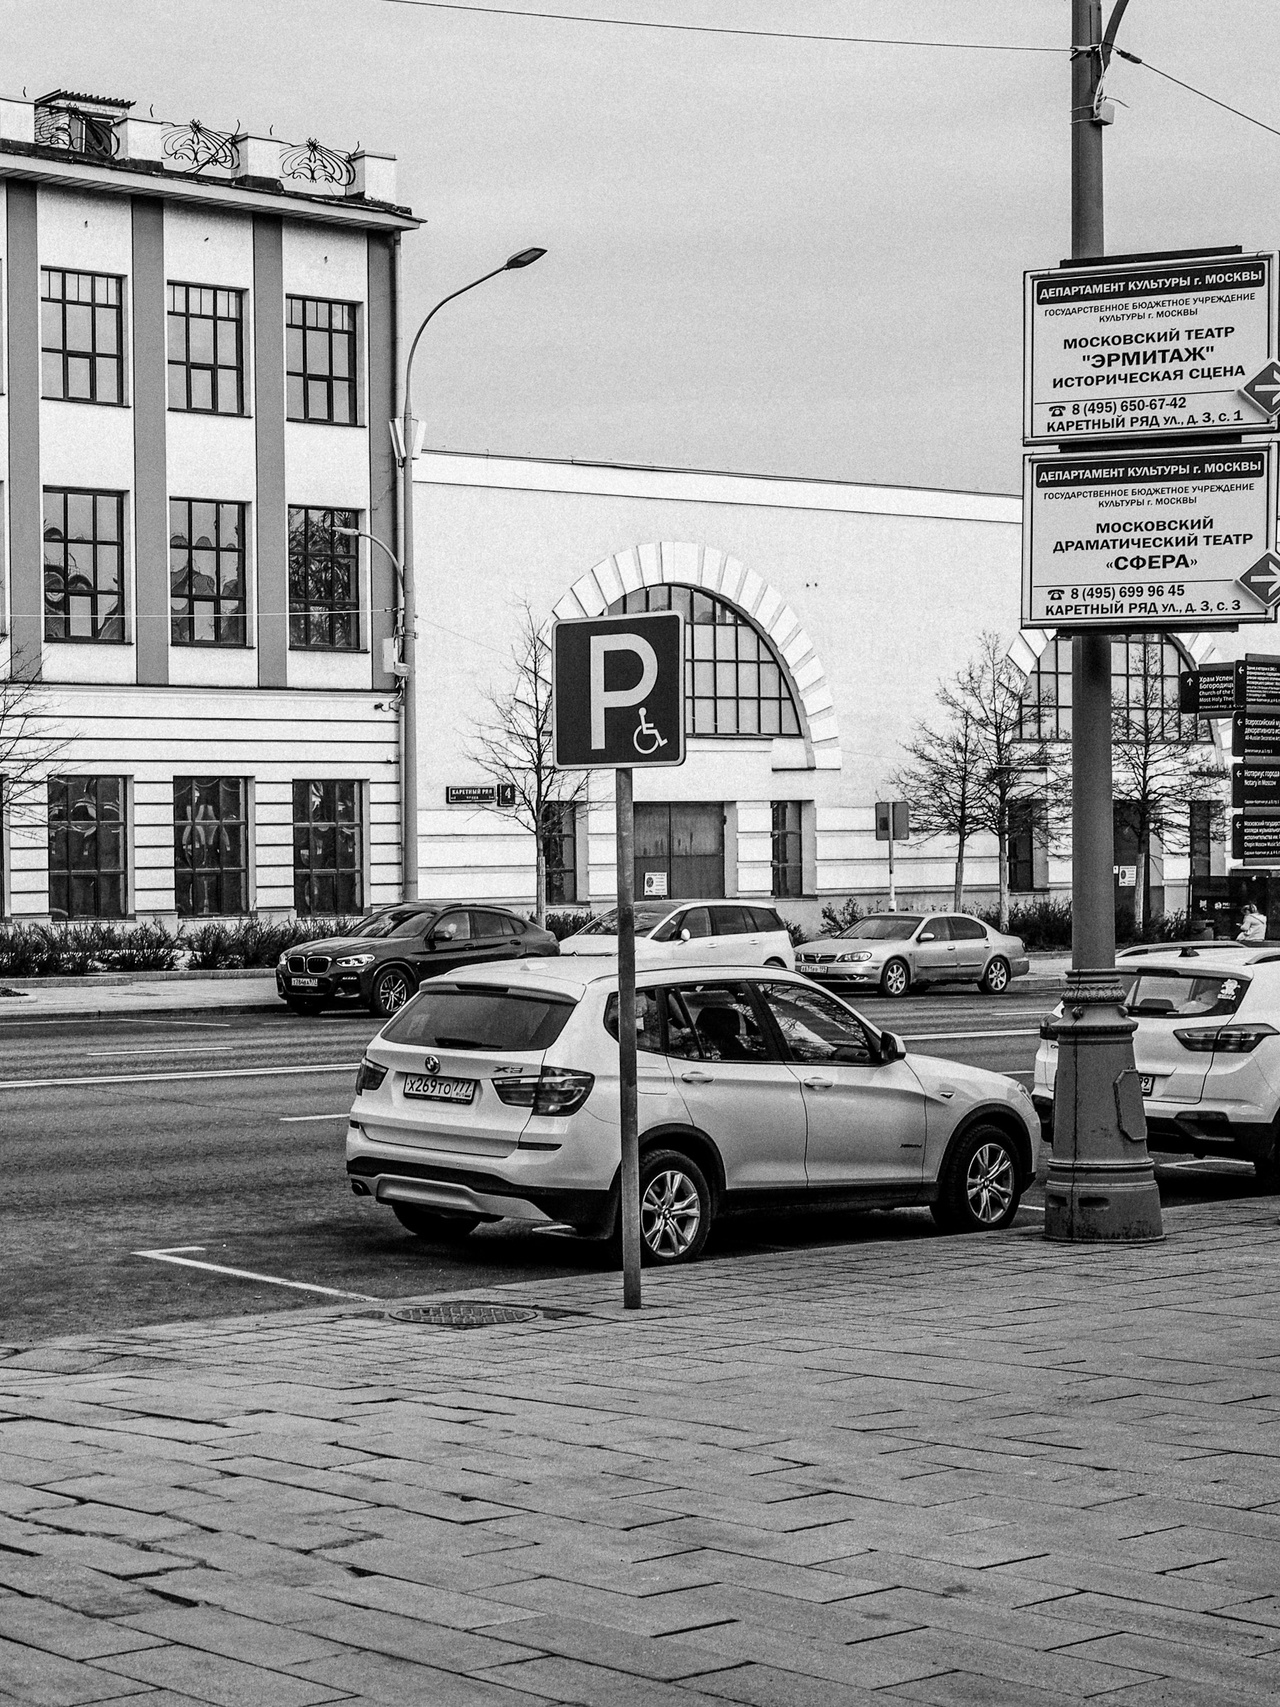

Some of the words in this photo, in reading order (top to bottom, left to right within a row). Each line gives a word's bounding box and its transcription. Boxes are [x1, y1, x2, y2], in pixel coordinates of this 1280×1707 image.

[1040, 283, 1125, 299] ДЕПАРТАМЕНТ
[1128, 277, 1190, 291] КУЛЬТУРЫ
[1205, 271, 1262, 284] МОСКВЫ
[1044, 303, 1130, 317] ГОСУДАРСТВЕННОЕ
[1132, 298, 1190, 310] БЮДЖЕТНОЕ
[1193, 293, 1255, 305] УЧРЕЖДЕНИЕ
[1099, 313, 1145, 322] КУЛЬТУРЫ
[1157, 309, 1198, 318] МОСКВЫ
[1063, 329, 1179, 349] МОСКОВСКИЙ
[1185, 327, 1235, 340] ТЕАТР
[1083, 346, 1214, 368] "ЭРМИТАЖ"
[1053, 370, 1183, 388] ИСТОРИЧЕСКАЯ
[1189, 366, 1245, 380] СЦЕНА
[1072, 404, 1080, 415] 8
[1084, 402, 1117, 417] (495)
[1121, 398, 1186, 412] 650-67-42
[1047, 416, 1125, 432] КАРЕТНЫЙ
[1130, 416, 1160, 428] РЯД
[1164, 416, 1184, 426] ул.,
[1187, 415, 1199, 425] д.
[1202, 413, 1215, 424] 3,
[1219, 413, 1230, 421] с.
[1234, 410, 1243, 420] 1
[1039, 468, 1124, 482] ДЕПАРТАМЕНТ
[1128, 465, 1190, 476] КУЛЬТУРЫ
[1204, 461, 1261, 473] МОСКВЫ
[1044, 489, 1129, 500] ГОСУДАРСТВЕННОЕ
[1131, 486, 1189, 496] БЮДЖЕТНОЕ
[1192, 483, 1254, 493] УЧРЕЖДЕНИЕ
[1098, 499, 1145, 508] КУЛЬТУРЫ
[1096, 516, 1214, 533] МОСКОВСКИЙ
[1053, 532, 1198, 553] ДРАМАТИЧЕСКИЙ
[1203, 534, 1253, 546] ТЕАТР
[1106, 554, 1198, 570] «СФЕРА»
[1071, 588, 1078, 599] 8
[1082, 587, 1116, 601] (495)
[1119, 587, 1144, 598] 699
[1148, 586, 1164, 596] 96
[1168, 585, 1185, 595] 45
[1046, 601, 1124, 616] КАРЕТНЫЙ
[1129, 602, 1158, 614] РЯД
[1161, 603, 1182, 613] ул.,
[1185, 603, 1196, 613] д.
[1200, 601, 1213, 612] 3,
[1231, 600, 1241, 610] 3
[590, 633, 658, 749] P
[505, 787, 511, 798] 4
